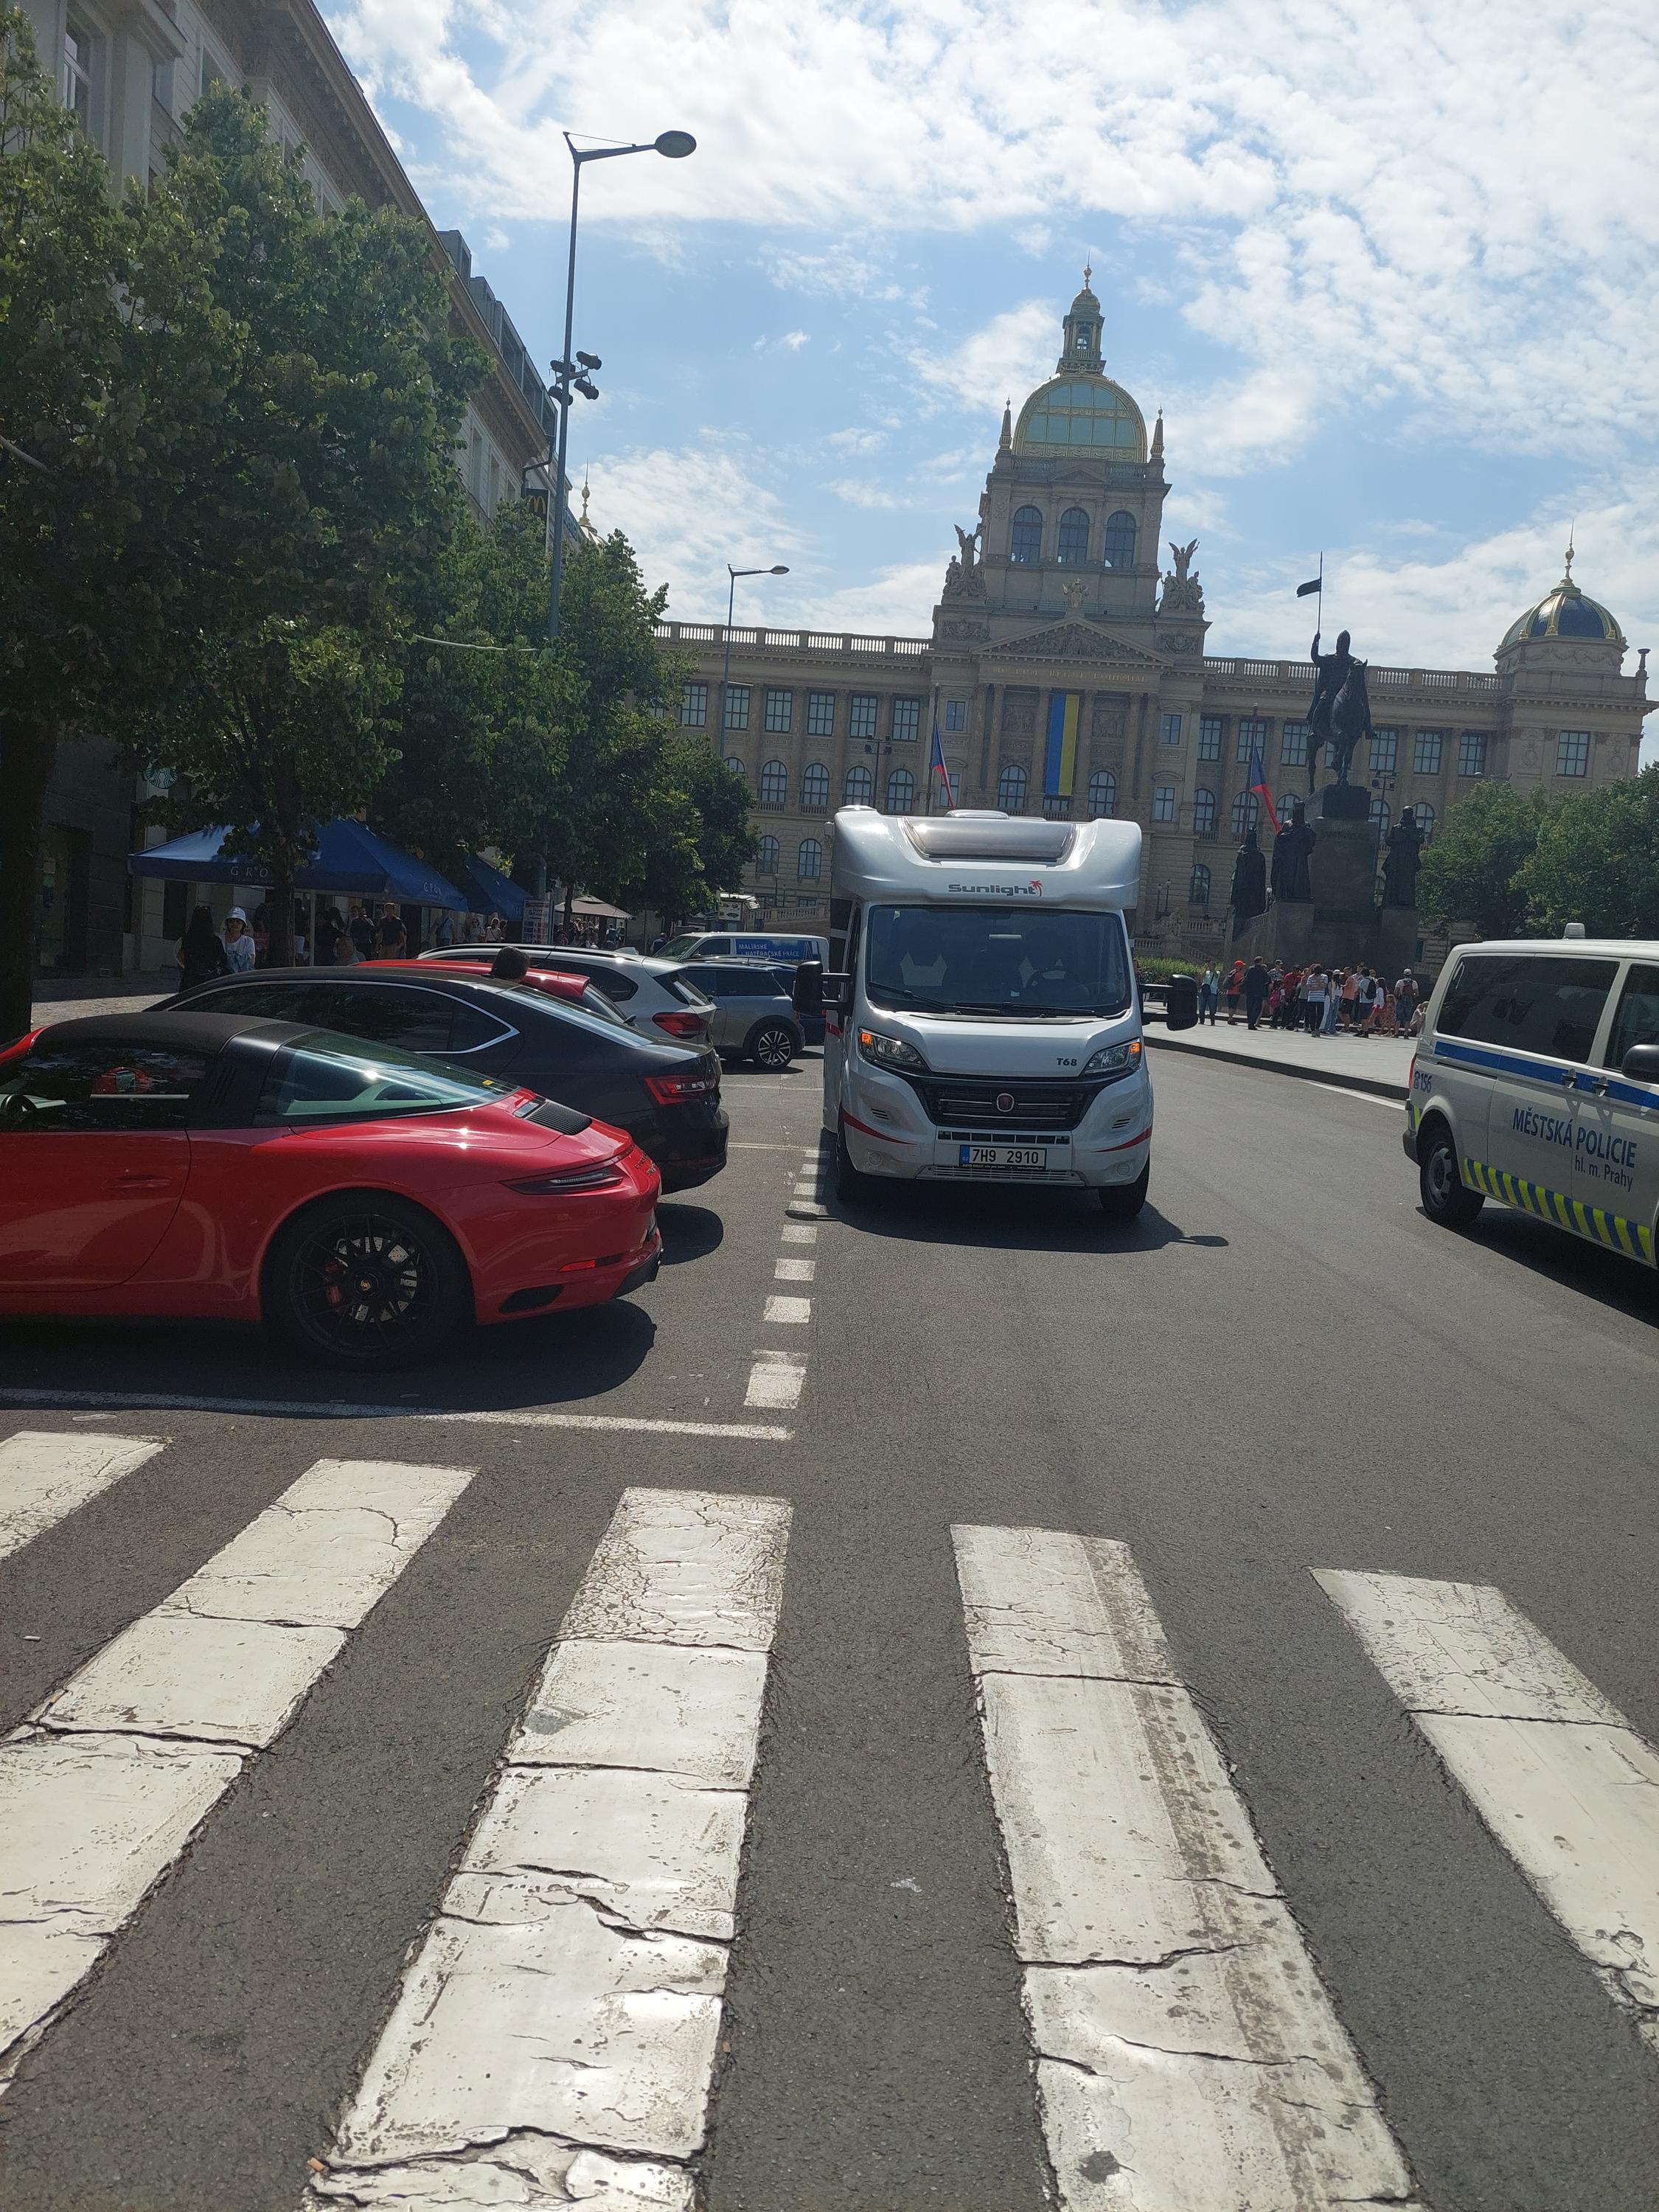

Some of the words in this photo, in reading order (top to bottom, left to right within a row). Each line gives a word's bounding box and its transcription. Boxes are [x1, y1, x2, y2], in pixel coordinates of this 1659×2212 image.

[948, 883, 1037, 896] Sunlight
[1056, 1057, 1077, 1066] T68
[1420, 1073, 1433, 1093] 156
[1512, 1106, 1574, 1148] MĚSTSKÁ
[1576, 1126, 1638, 1168] POLICIE
[972, 1149, 997, 1163] 7H9
[1006, 1150, 1040, 1164] 2910
[1575, 1156, 1586, 1174] hl.
[1588, 1164, 1601, 1178] m.
[1604, 1164, 1635, 1192] Prahy
